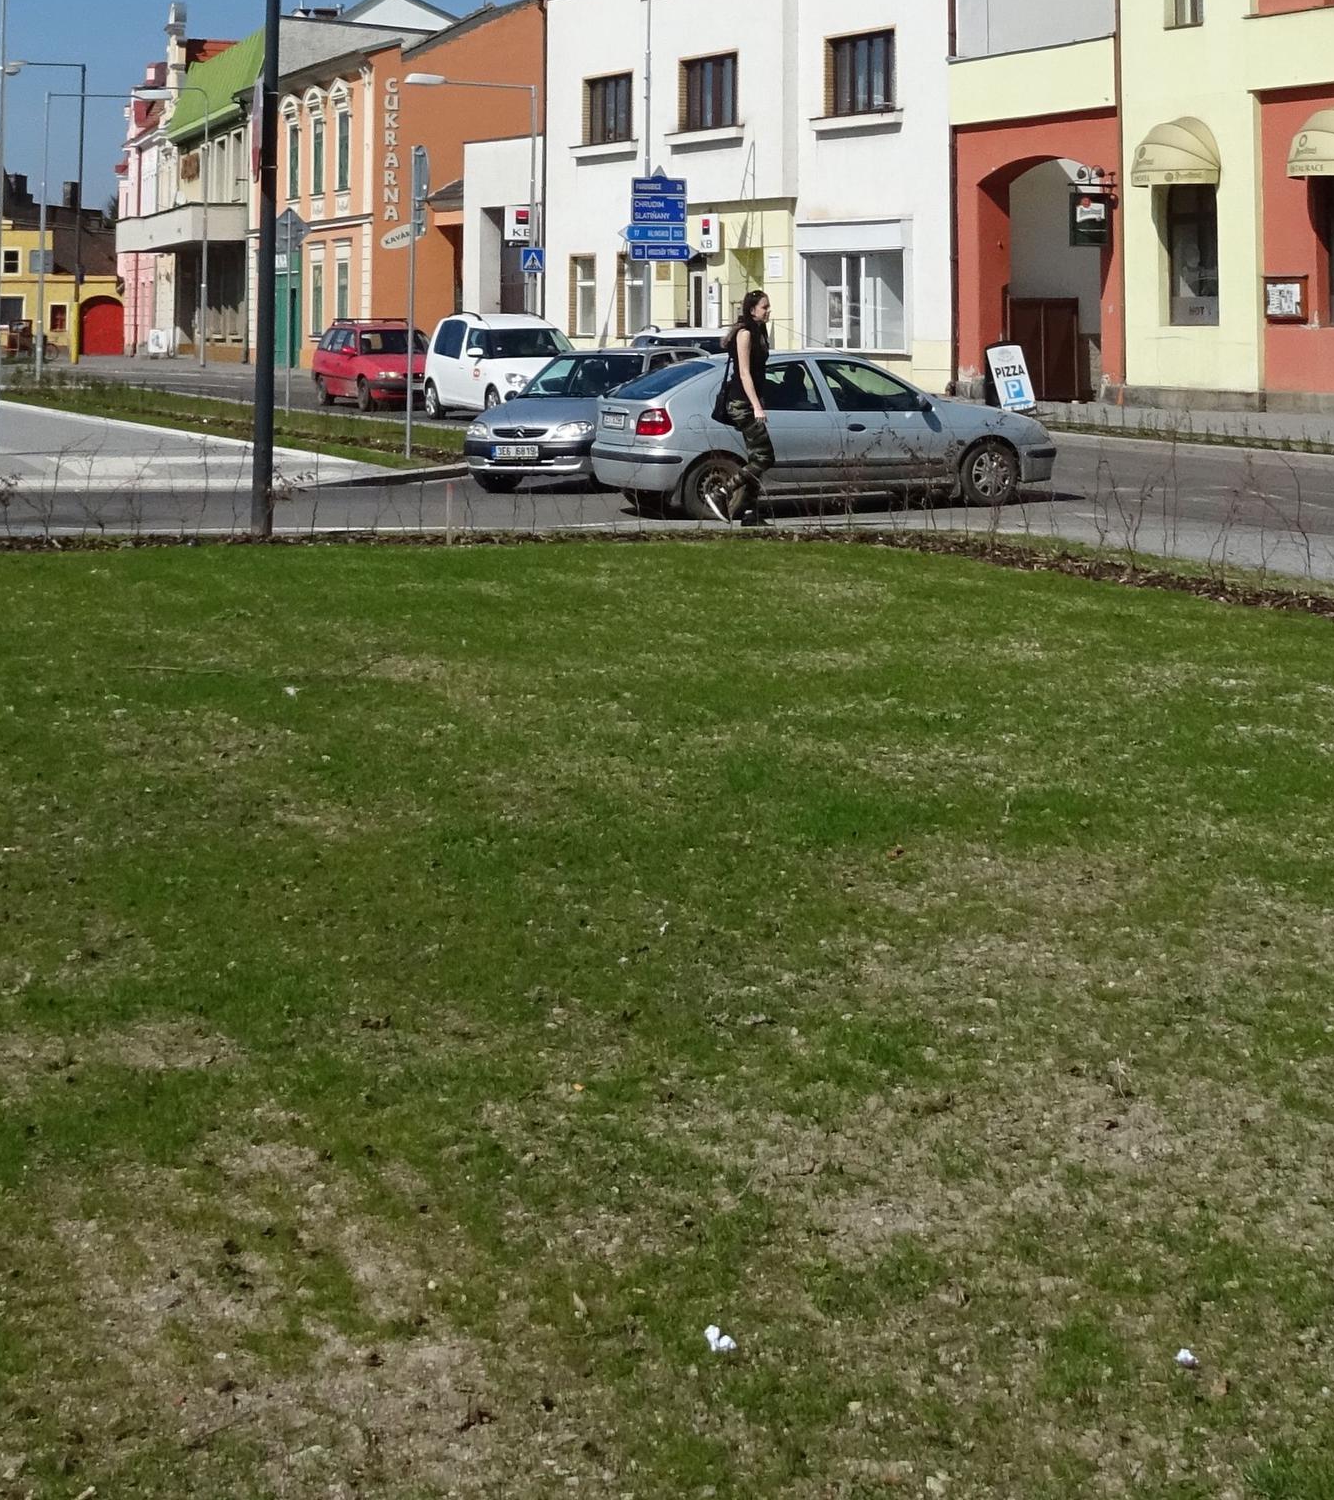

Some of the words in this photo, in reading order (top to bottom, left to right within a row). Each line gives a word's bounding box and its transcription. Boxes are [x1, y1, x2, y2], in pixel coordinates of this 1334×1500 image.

[384, 77, 400, 222] CUKRÁRNA
[994, 364, 1026, 378] PIZZA
[1007, 381, 1020, 398] P
